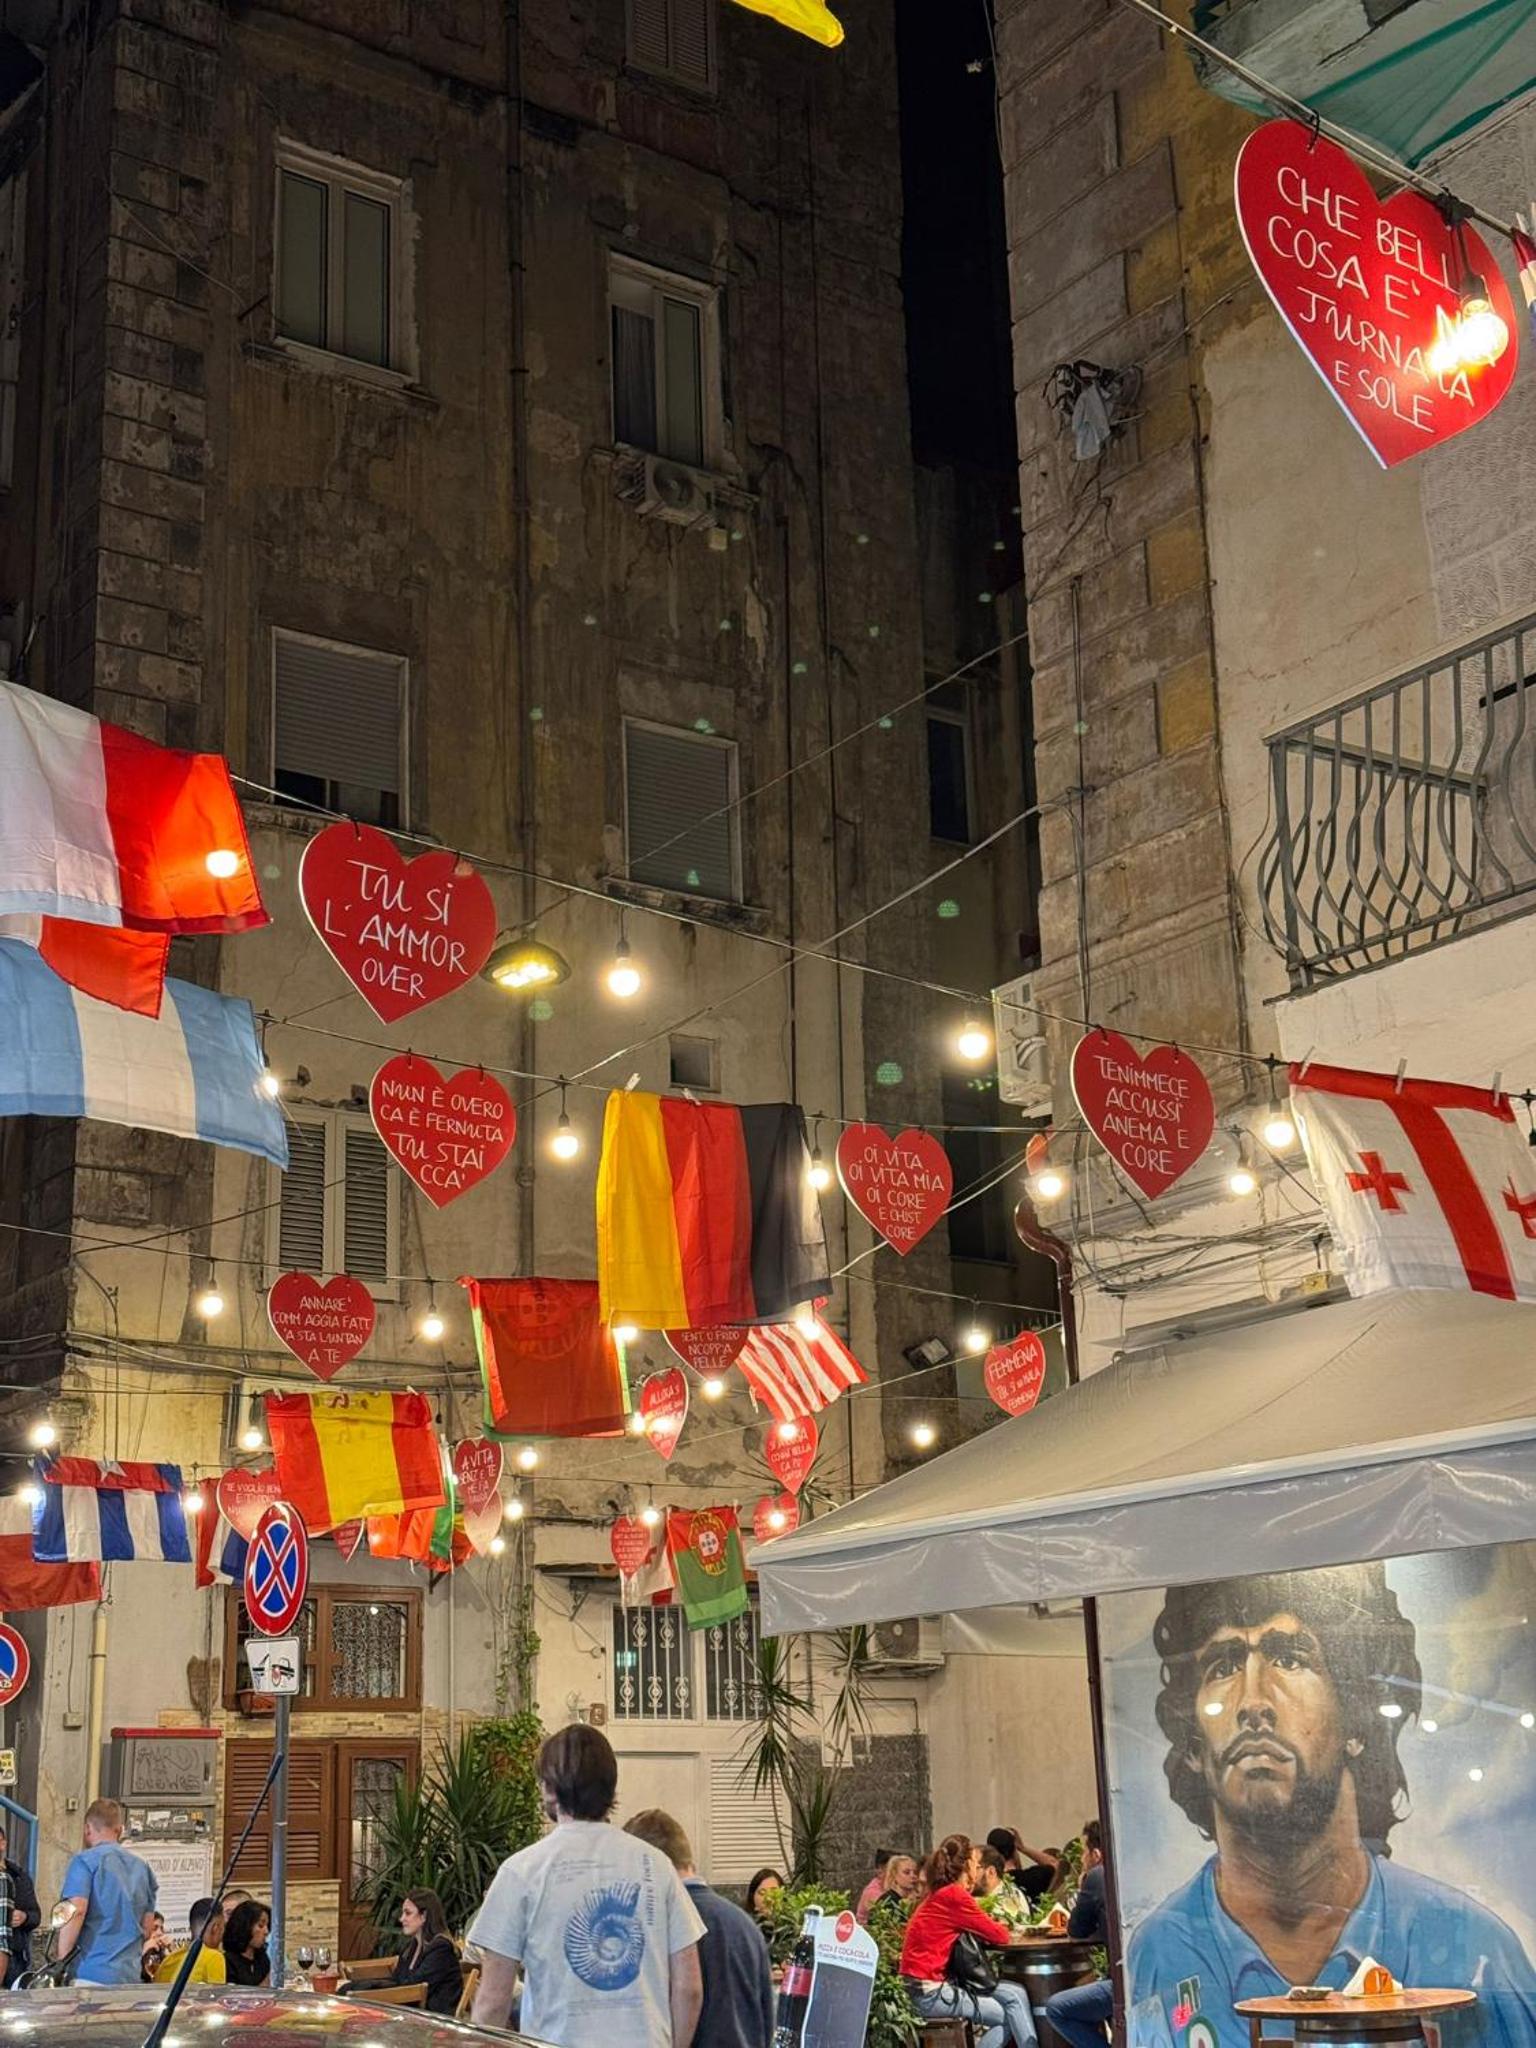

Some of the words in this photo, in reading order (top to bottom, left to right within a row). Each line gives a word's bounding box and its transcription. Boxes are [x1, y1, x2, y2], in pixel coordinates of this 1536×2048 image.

[1277, 167, 1361, 239] CHE
[1268, 215, 1370, 299] COSA
[1335, 360, 1351, 388] E
[1359, 369, 1435, 433] SOLE
[346, 859, 413, 912] TU
[362, 958, 426, 999] OVER
[1093, 1054, 1191, 1099] TENIMMECE
[381, 1080, 424, 1103] NUN
[451, 1094, 504, 1120] OVERO
[380, 1104, 404, 1123] CA
[426, 1112, 504, 1143] FERNUTA
[1102, 1113, 1168, 1145] ANEMA
[1178, 1129, 1190, 1149] E
[390, 1132, 430, 1160] TU
[1122, 1142, 1176, 1175] CORE
[887, 1190, 927, 1209] CORE
[885, 1224, 918, 1240] CORE
[296, 1329, 317, 1342] STA
[304, 1314, 340, 1329] AGGIA
[307, 1348, 320, 1363] A
[321, 1348, 342, 1364] TE
